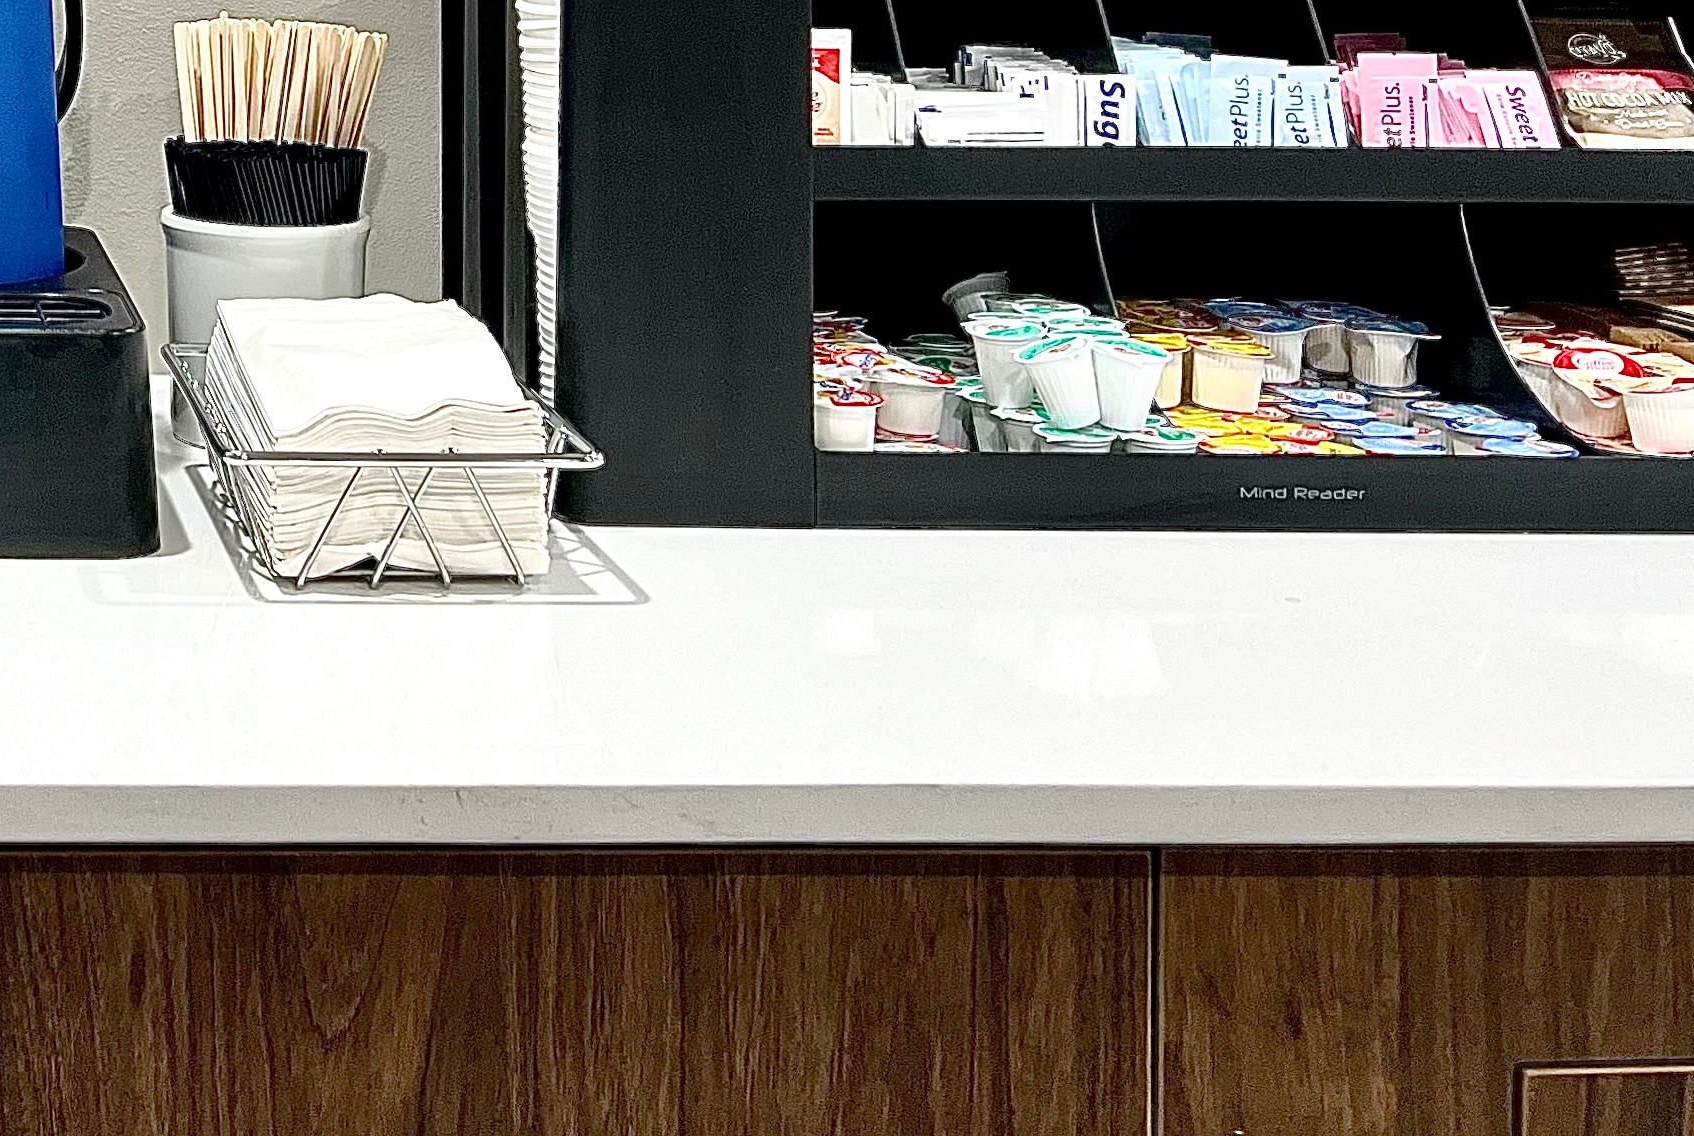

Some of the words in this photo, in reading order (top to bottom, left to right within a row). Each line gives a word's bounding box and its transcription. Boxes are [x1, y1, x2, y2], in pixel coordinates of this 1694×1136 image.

[1565, 90, 1600, 108] HOT
[1600, 91, 1657, 108] COCOA
[1657, 90, 1693, 106] MIX
[1093, 79, 1125, 146] Sug
[1239, 486, 1287, 500] Mind
[1293, 486, 1366, 500] Reader
